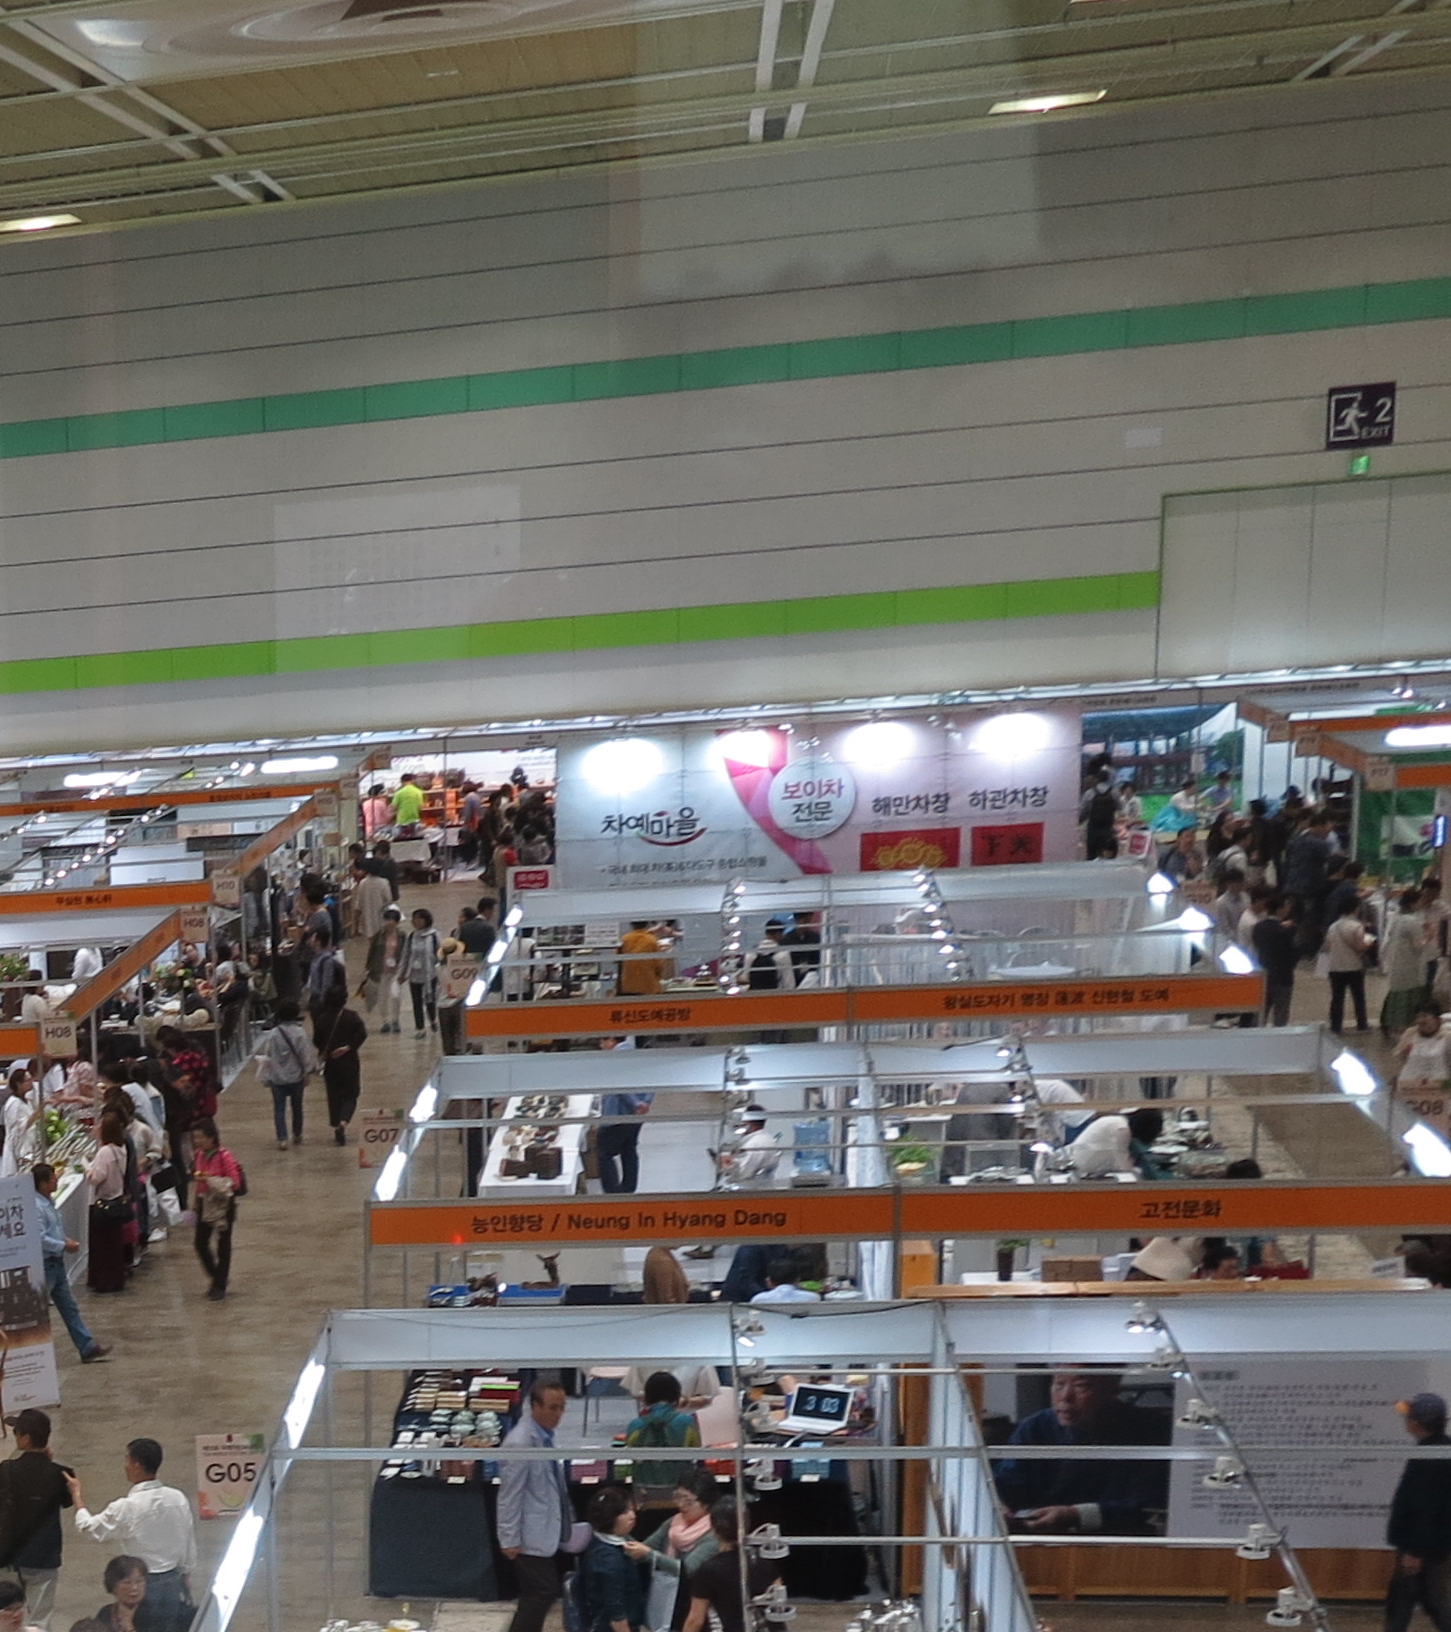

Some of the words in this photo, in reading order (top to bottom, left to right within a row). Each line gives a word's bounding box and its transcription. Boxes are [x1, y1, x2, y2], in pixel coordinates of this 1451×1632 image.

[1375, 397, 1393, 423] 2
[1361, 425, 1391, 439] EXIT
[781, 778, 844, 800] 보이차
[872, 793, 951, 815] 해만차창
[968, 786, 1049, 809] 하관차창
[600, 806, 701, 840] 차예마을
[790, 802, 834, 823] 전문
[365, 1128, 399, 1143] G07
[1140, 1199, 1222, 1221] 고전문화
[470, 1213, 543, 1234] 능인향당
[567, 1212, 630, 1236] Neung
[639, 1212, 655, 1229] In
[663, 1210, 726, 1235] Hyang
[734, 1209, 787, 1228] Dang
[205, 1462, 257, 1483] G05
